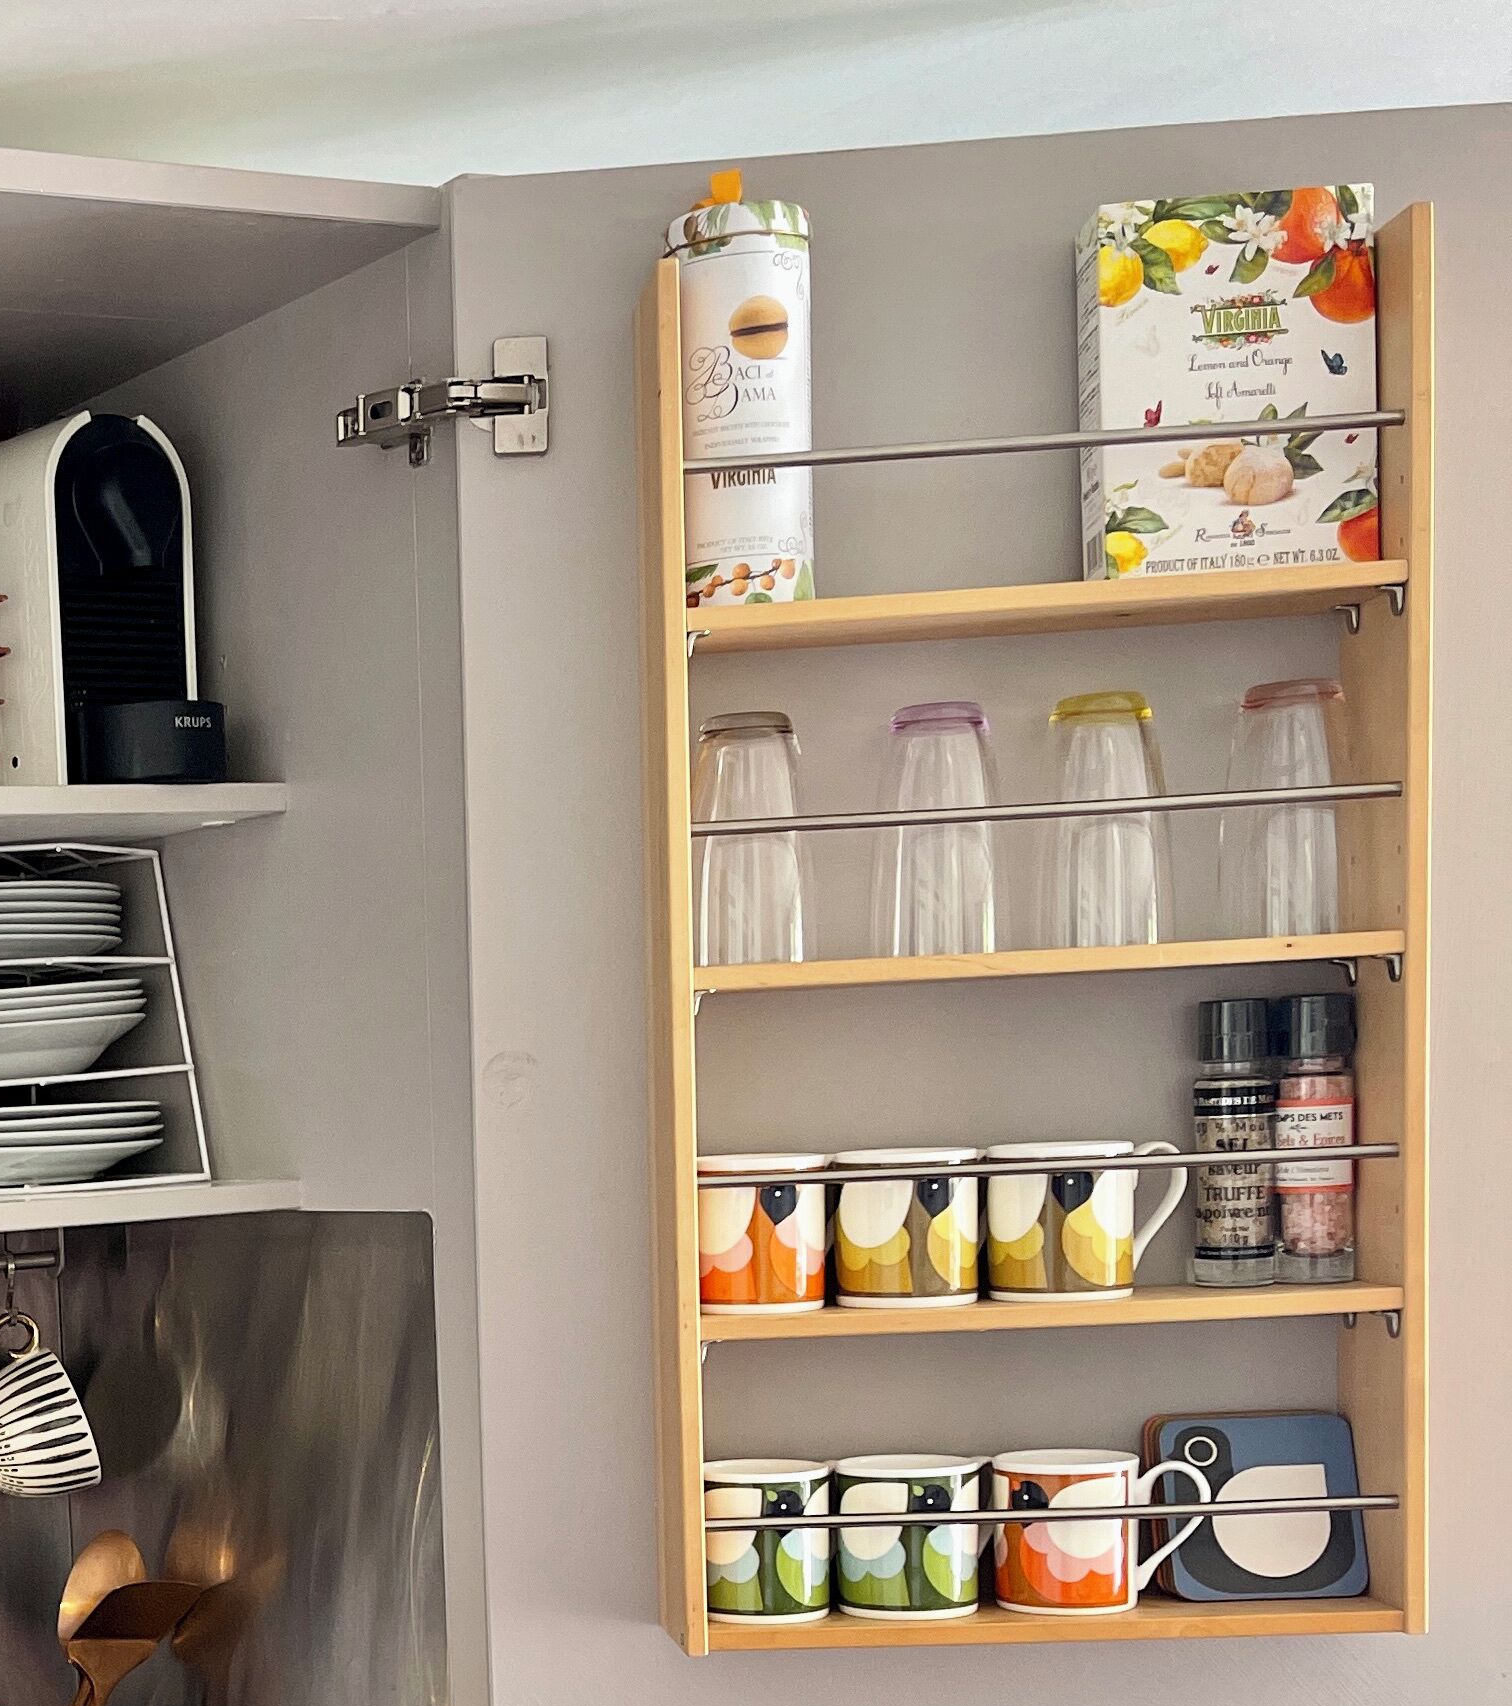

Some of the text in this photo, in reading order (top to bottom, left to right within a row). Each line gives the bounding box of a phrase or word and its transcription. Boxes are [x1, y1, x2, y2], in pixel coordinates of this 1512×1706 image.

[1196, 303, 1281, 334] VIRGINIA
[1188, 349, 1293, 375] Lemon and Orange
[1145, 558, 1185, 575] PRODUCT
[1187, 557, 1198, 571] OF
[1199, 553, 1229, 570] ITALY
[1273, 551, 1288, 565] NET
[1309, 549, 1324, 562] 6.3
[174, 716, 212, 729] KRUPS
[1298, 1113, 1317, 1122] DES
[1320, 1111, 1344, 1121] METS
[1299, 1134, 1309, 1146] &
[1208, 1163, 1261, 1176] saveur
[1204, 1185, 1266, 1202] TRUFFE
